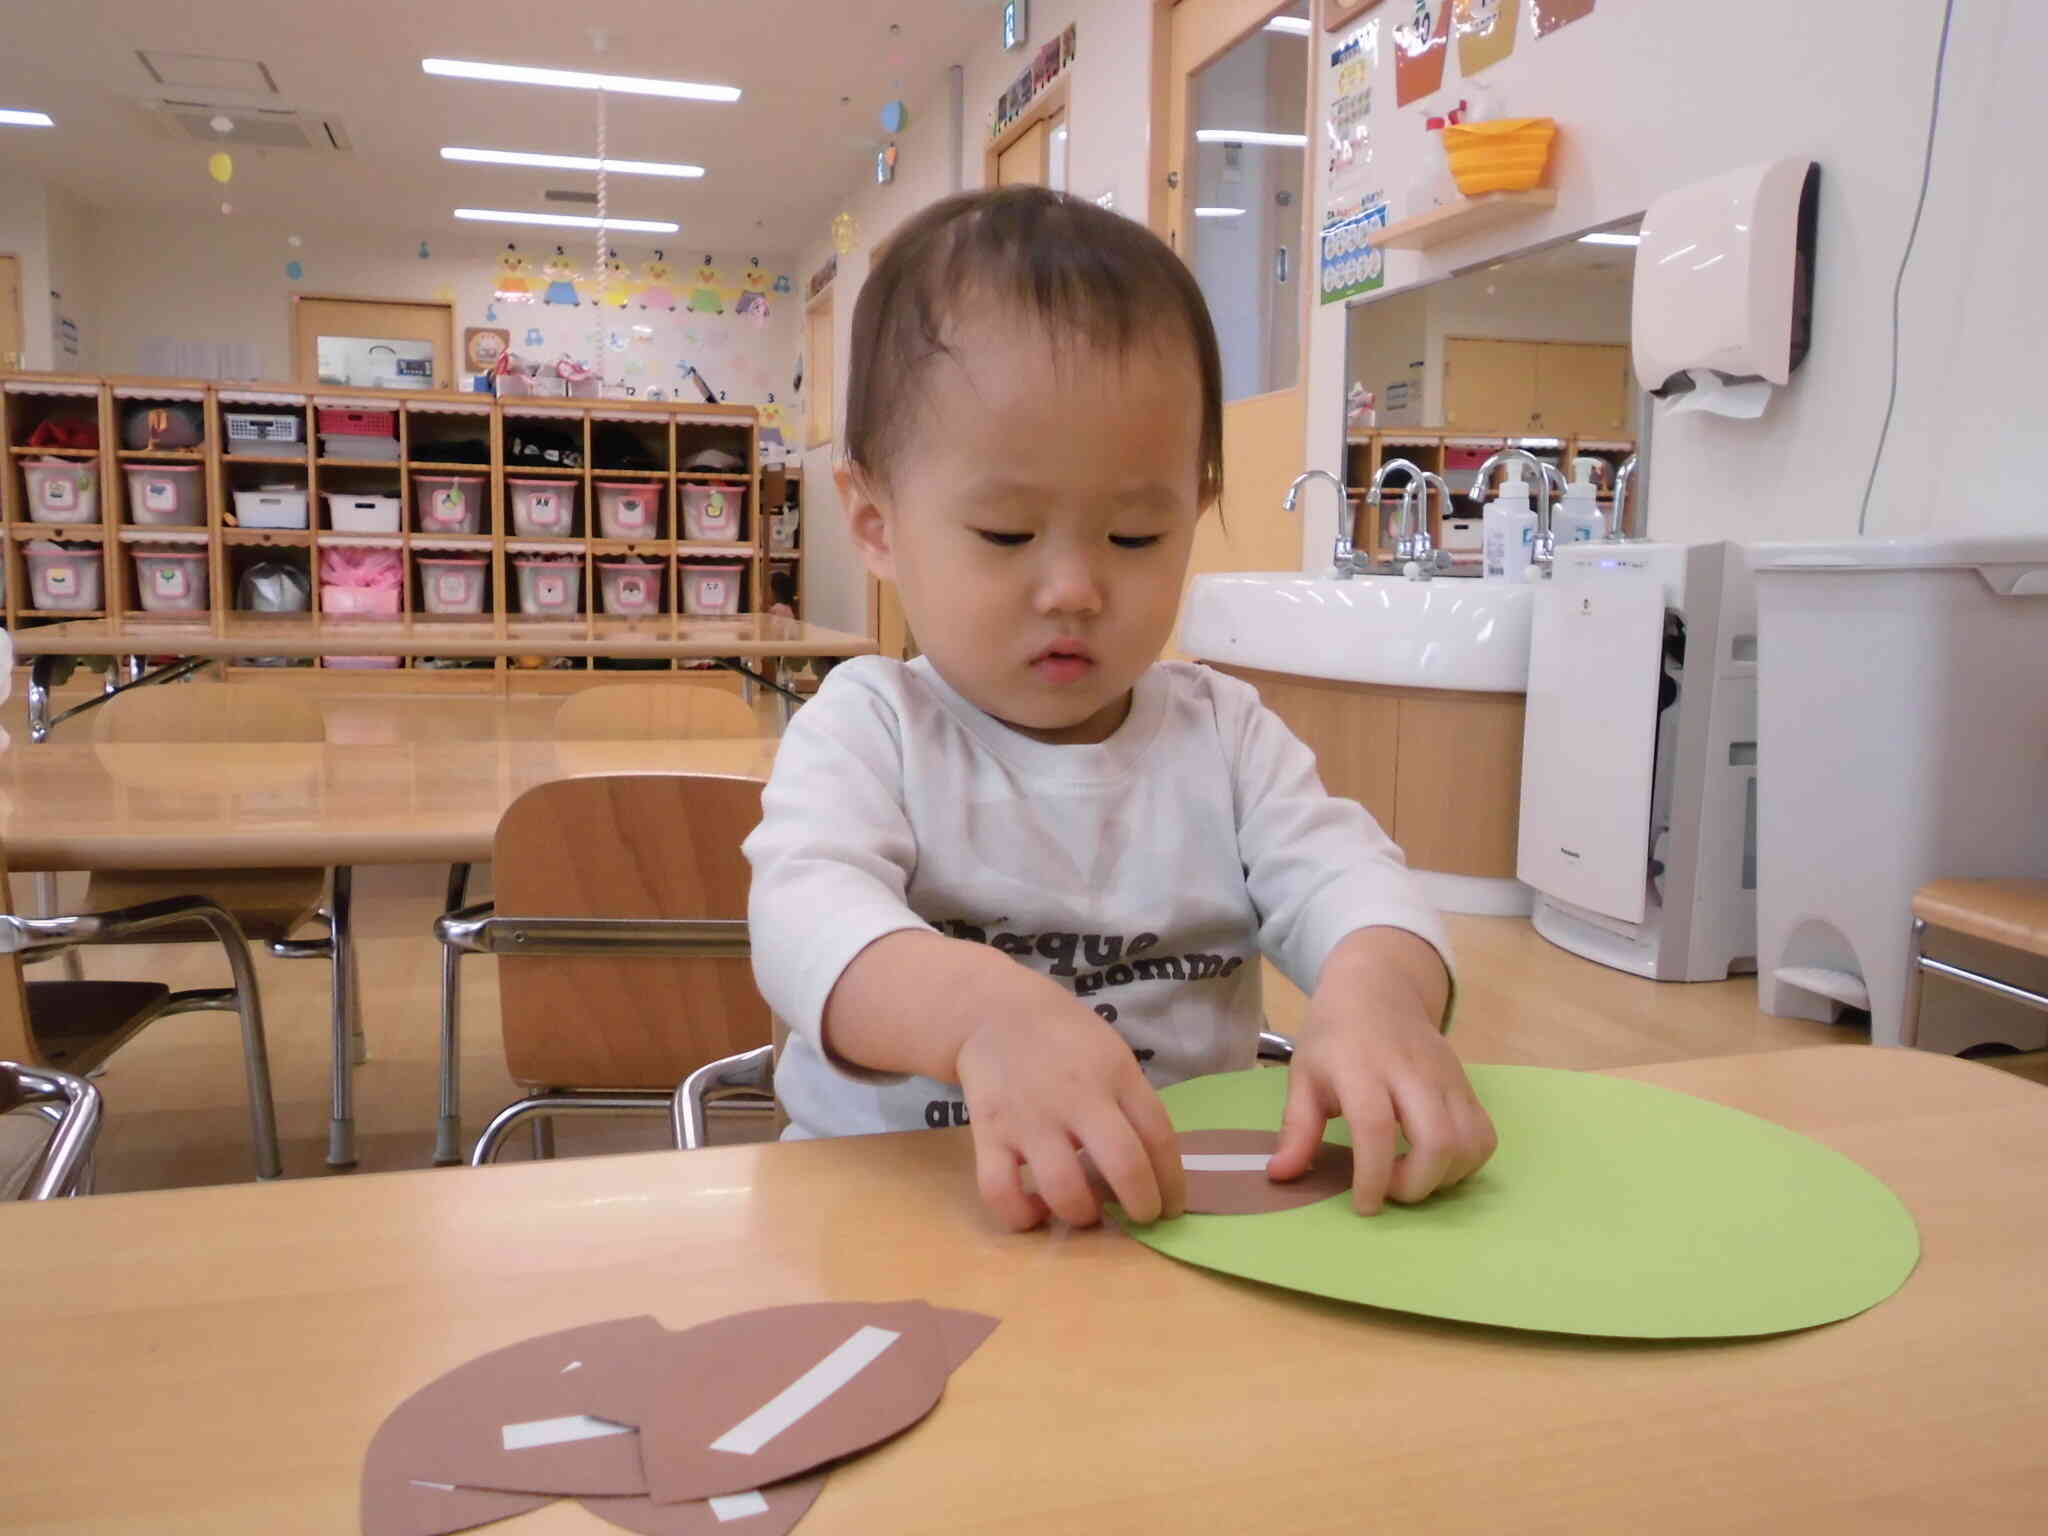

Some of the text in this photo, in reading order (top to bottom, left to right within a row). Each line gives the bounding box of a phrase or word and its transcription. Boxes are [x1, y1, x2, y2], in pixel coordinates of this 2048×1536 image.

[654, 249, 664, 261] 7
[703, 254, 713, 266] 8
[750, 256, 760, 269] 9
[768, 393, 775, 404] 3
